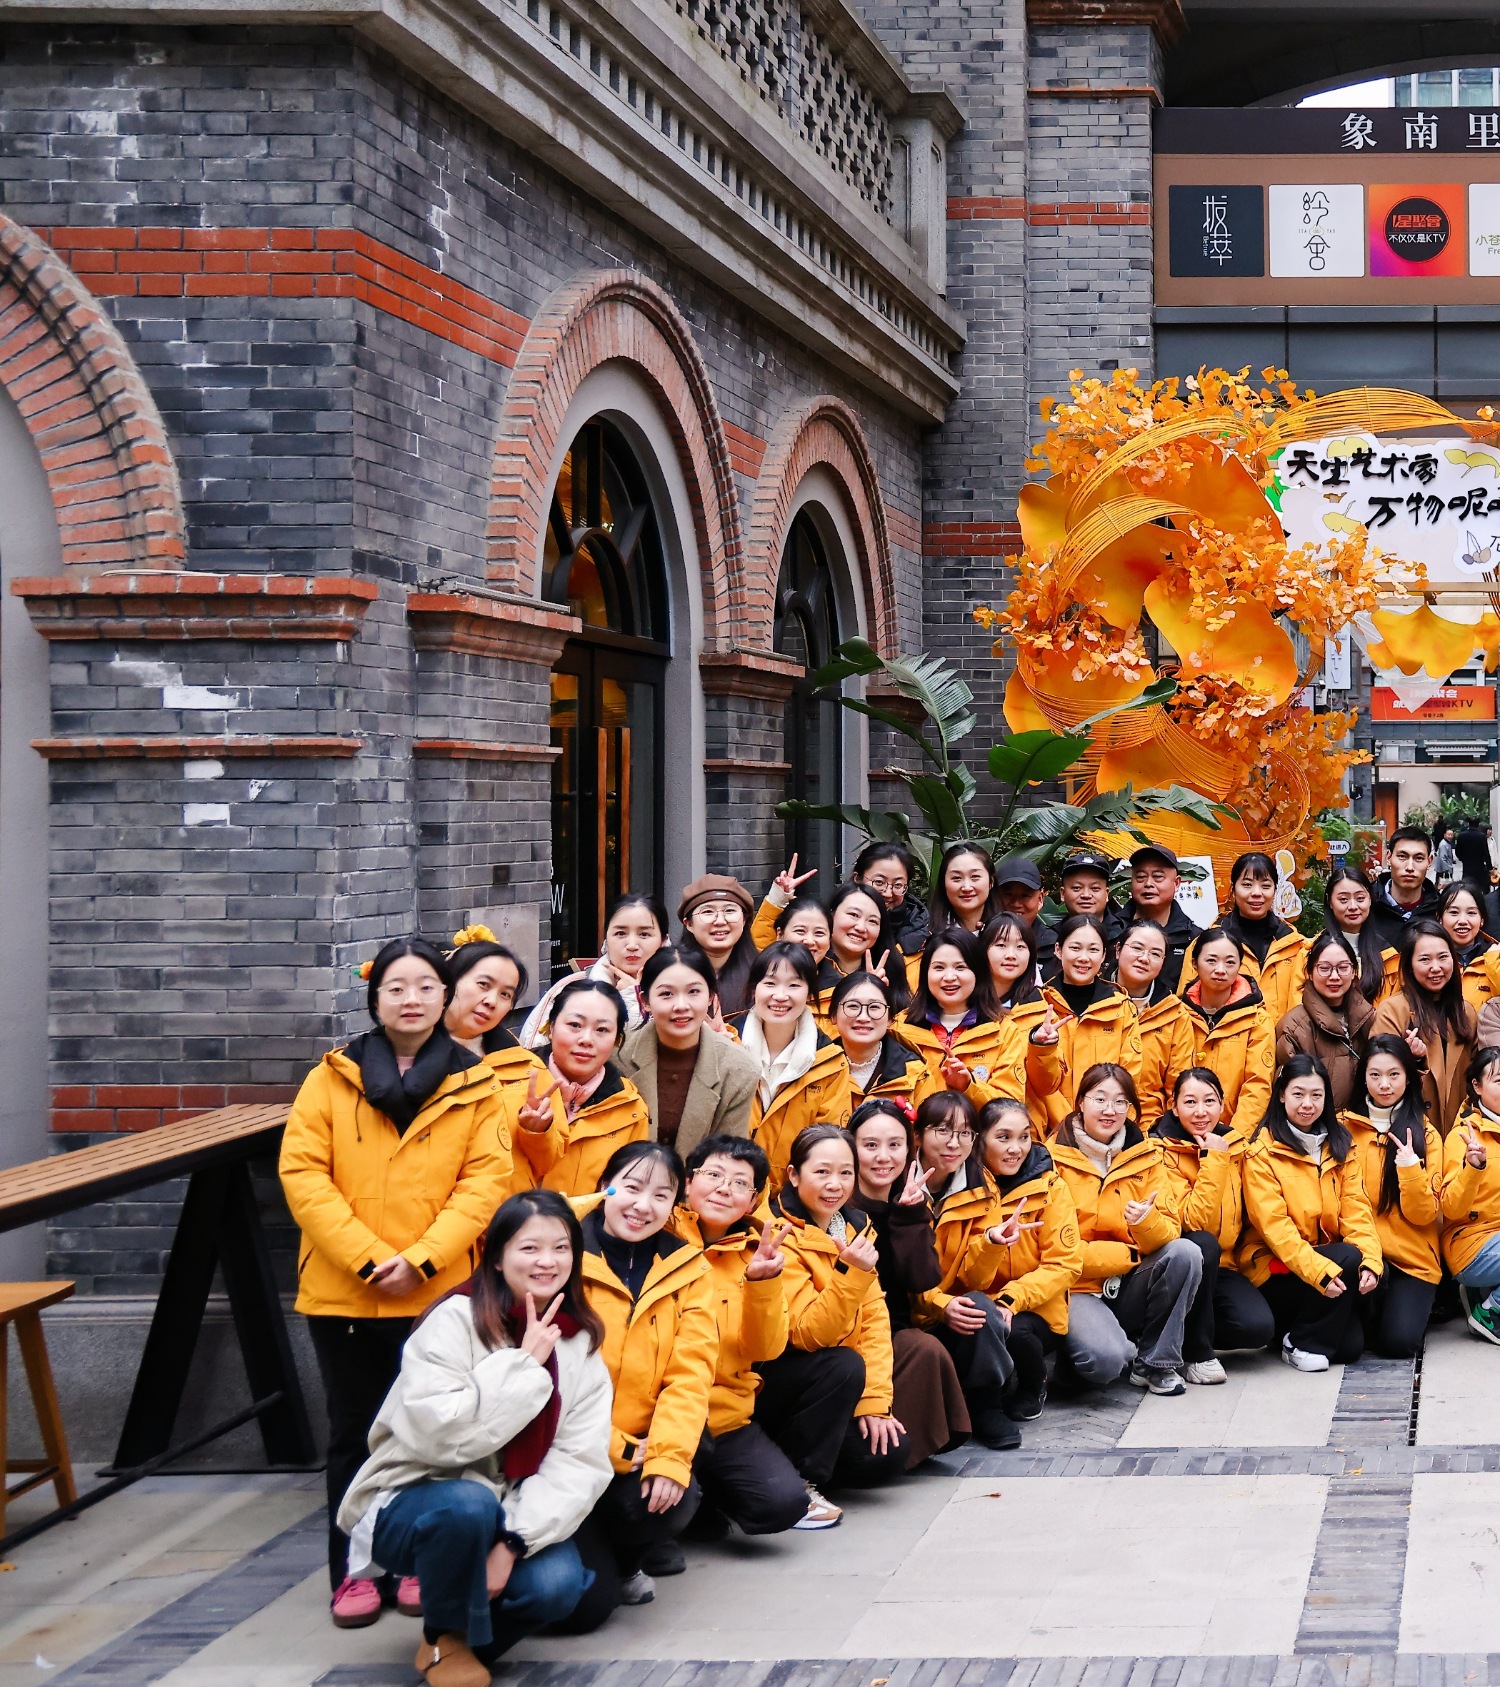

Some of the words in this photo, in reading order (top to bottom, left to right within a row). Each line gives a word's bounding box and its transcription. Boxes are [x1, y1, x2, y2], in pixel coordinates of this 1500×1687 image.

[1388, 233, 1446, 244] 不仅仅是KTV
[1287, 447, 1439, 486] 天生艺术家
